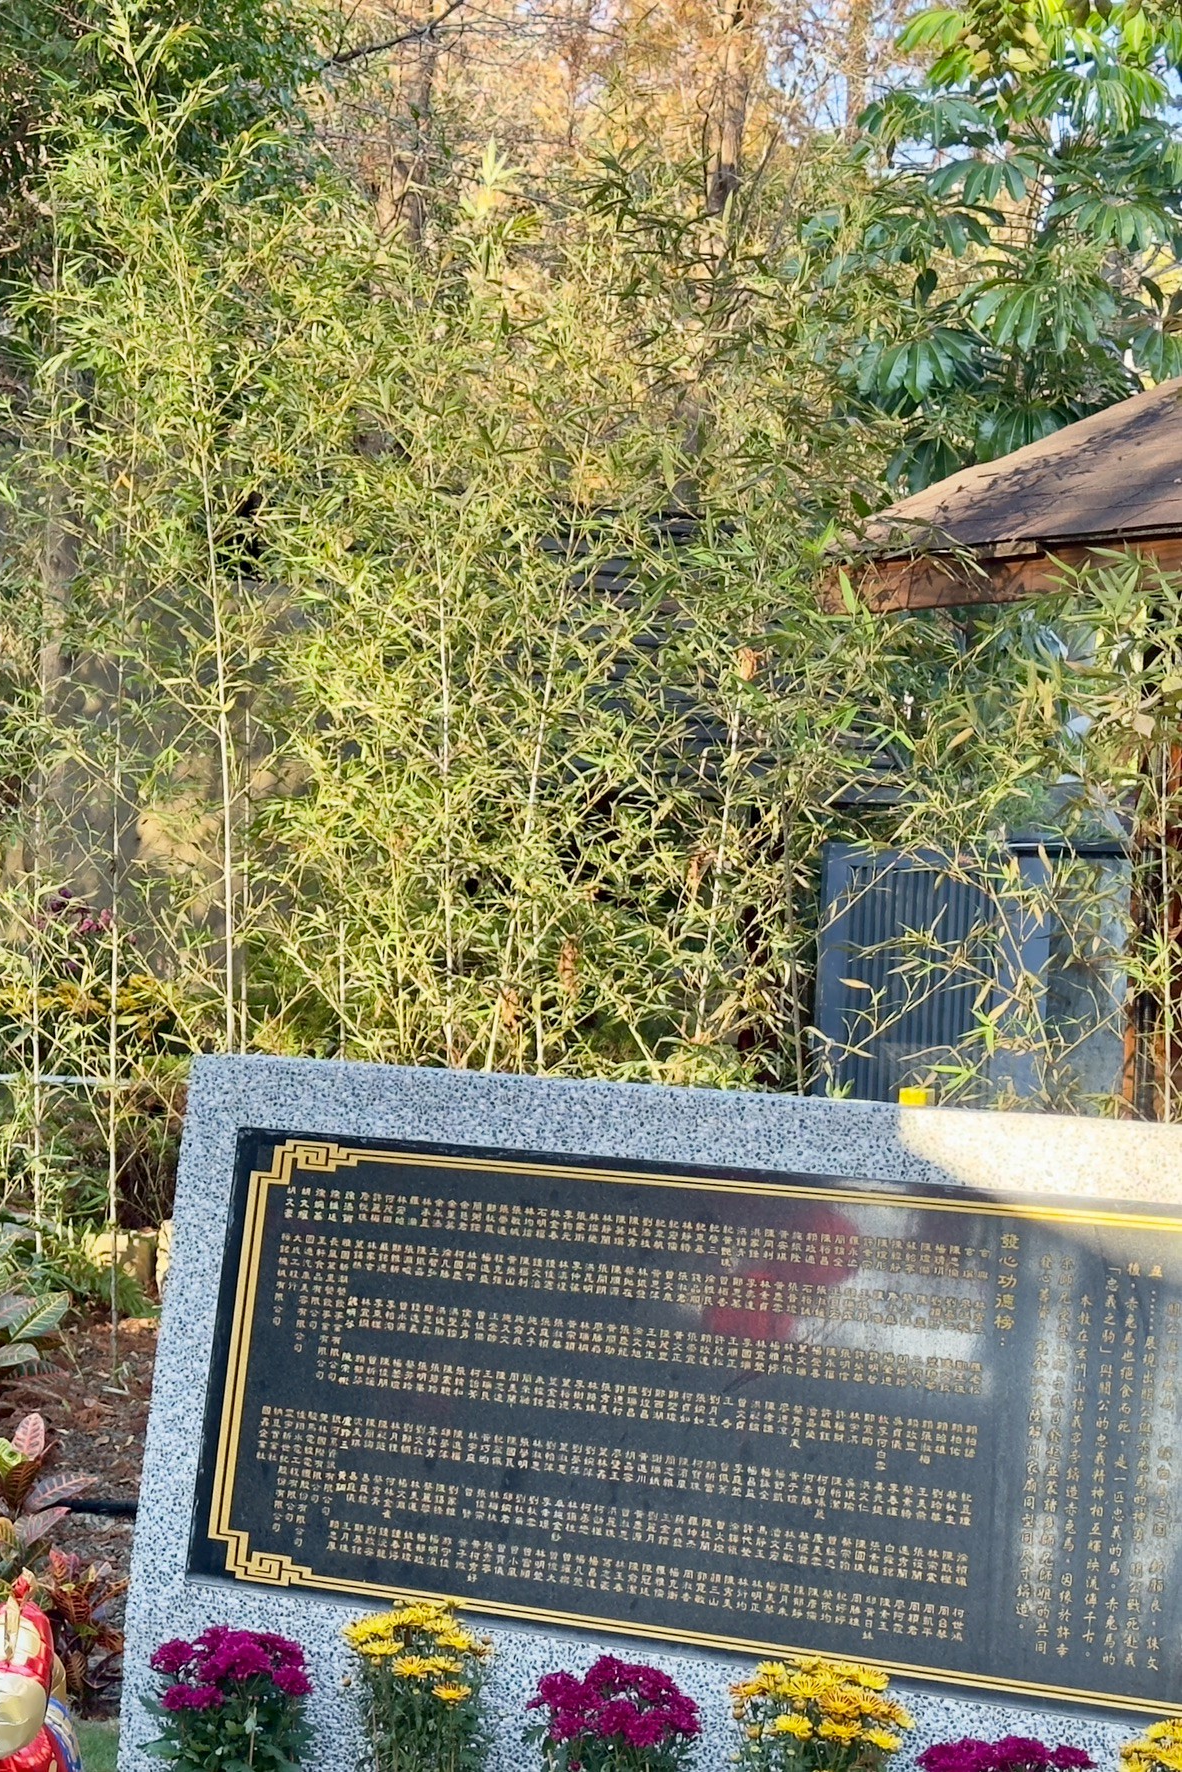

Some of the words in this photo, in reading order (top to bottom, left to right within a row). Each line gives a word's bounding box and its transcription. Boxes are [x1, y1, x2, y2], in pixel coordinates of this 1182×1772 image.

[994, 1231, 1020, 1347] 發心功德榜：
